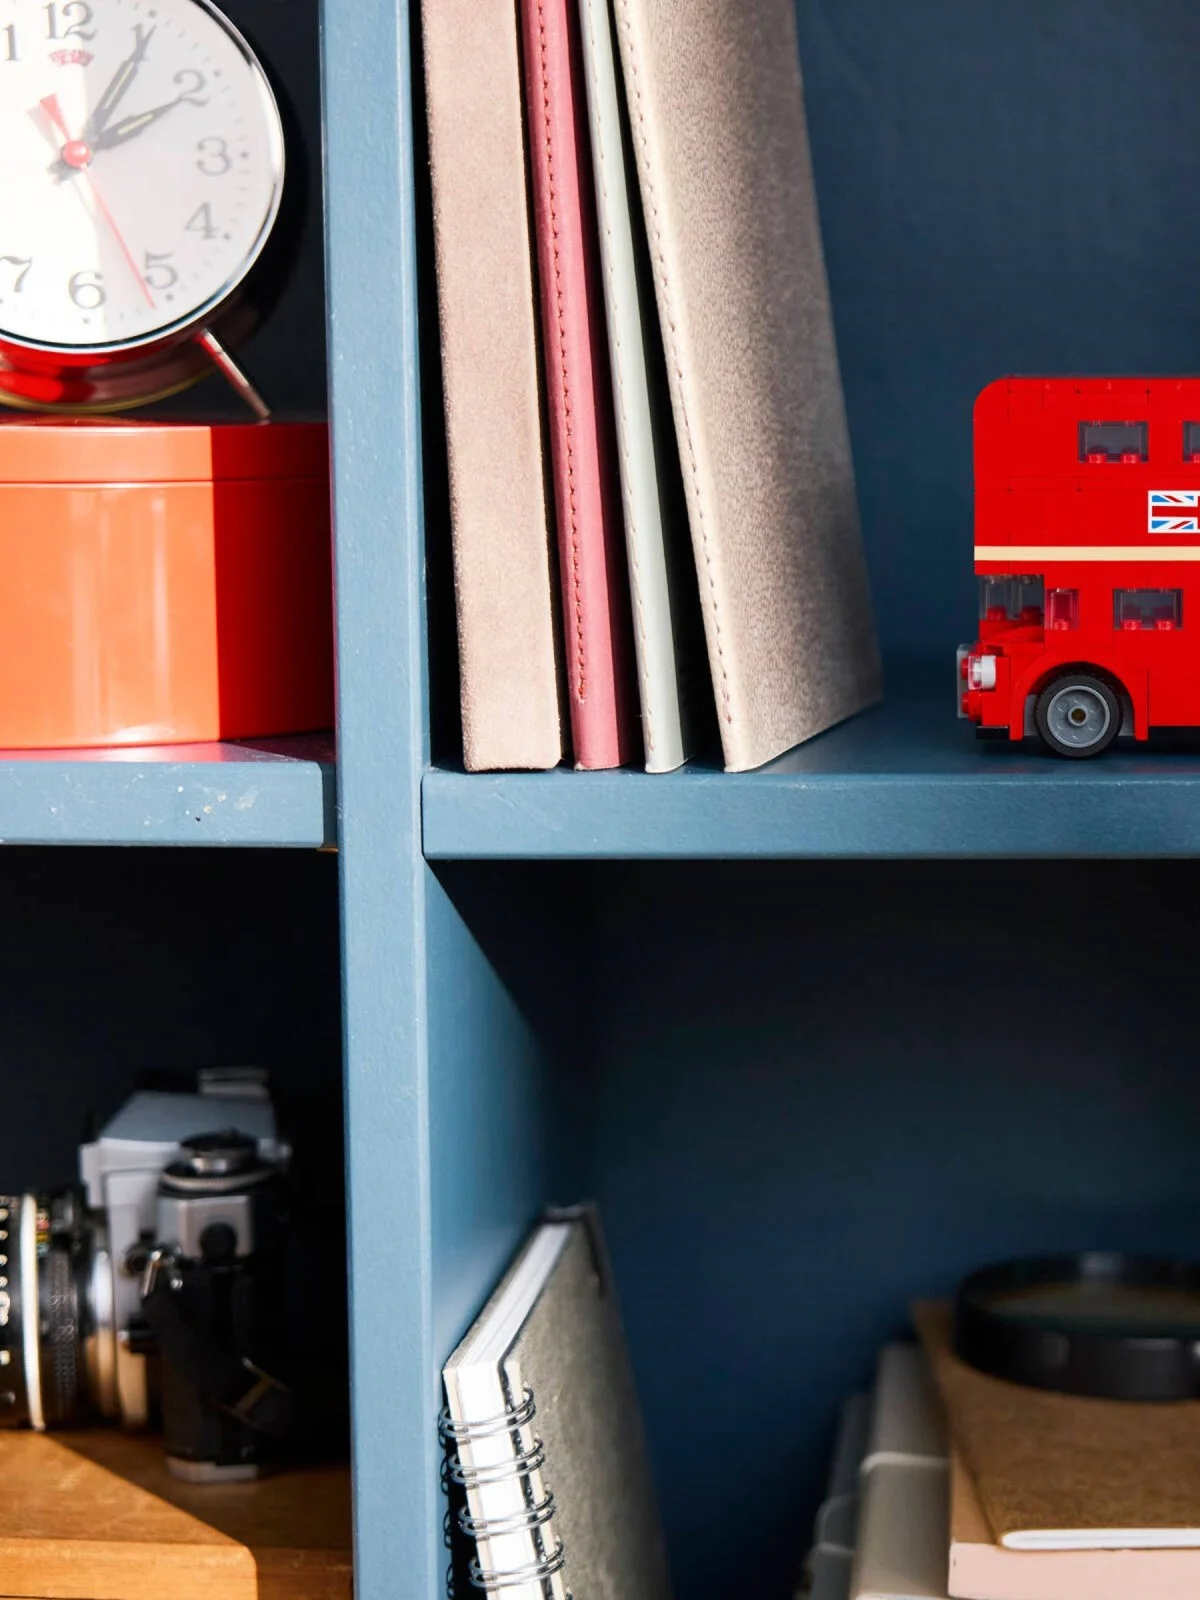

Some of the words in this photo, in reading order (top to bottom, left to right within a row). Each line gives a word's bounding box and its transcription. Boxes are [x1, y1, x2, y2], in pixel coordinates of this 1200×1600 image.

[43, 1, 98, 42] 12
[172, 69, 211, 107] 2
[195, 136, 232, 177] 3
[184, 202, 220, 240] 4
[0, 254, 33, 293] 7
[68, 270, 107, 310] 6
[144, 251, 178, 290] 5
